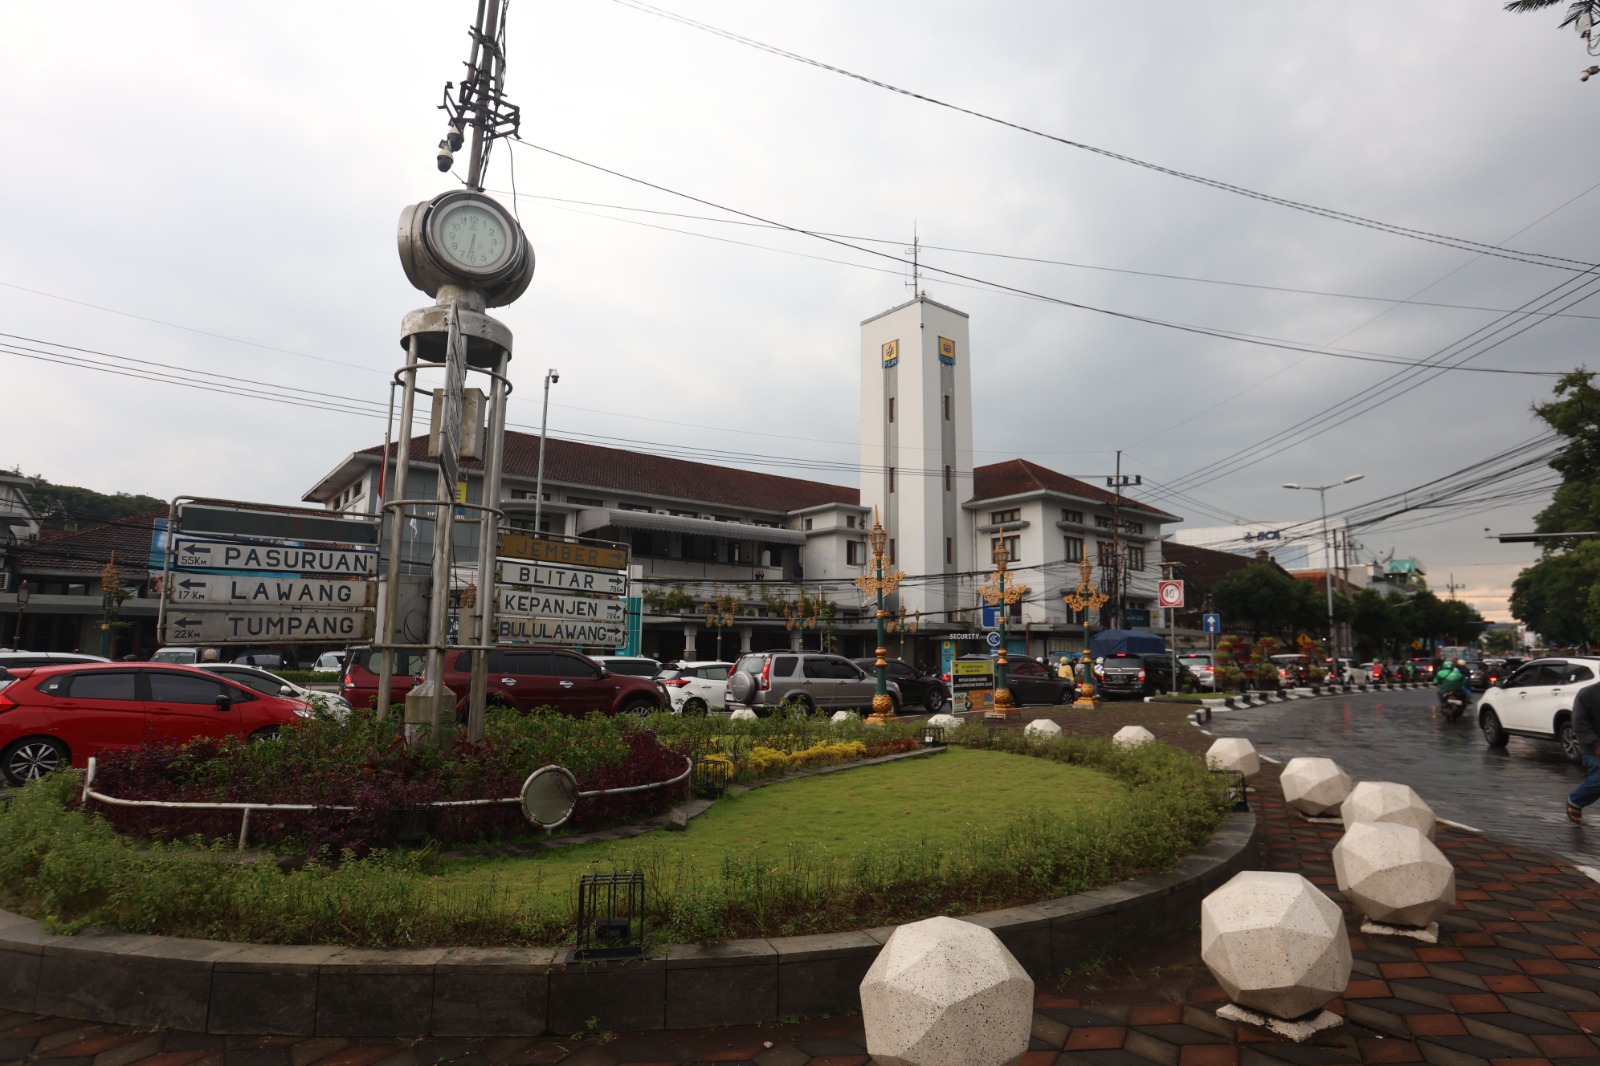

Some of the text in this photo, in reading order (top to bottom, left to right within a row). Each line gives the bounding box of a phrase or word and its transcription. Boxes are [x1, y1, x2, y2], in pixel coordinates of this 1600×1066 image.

[452, 223, 460, 231] 10
[470, 216, 478, 224] 12
[883, 358, 898, 368] PLN
[1257, 530, 1280, 540] BCA
[224, 547, 368, 572] PASURUAN
[516, 540, 599, 564] JEMBER
[520, 567, 594, 589] BLITAR
[178, 591, 190, 600] 17
[231, 581, 352, 602] LAWANG
[1165, 589, 1174, 598] 40
[505, 594, 598, 616] KEPANJEN
[228, 616, 354, 636] TUMPANG
[500, 620, 606, 640] BULULAWANG
